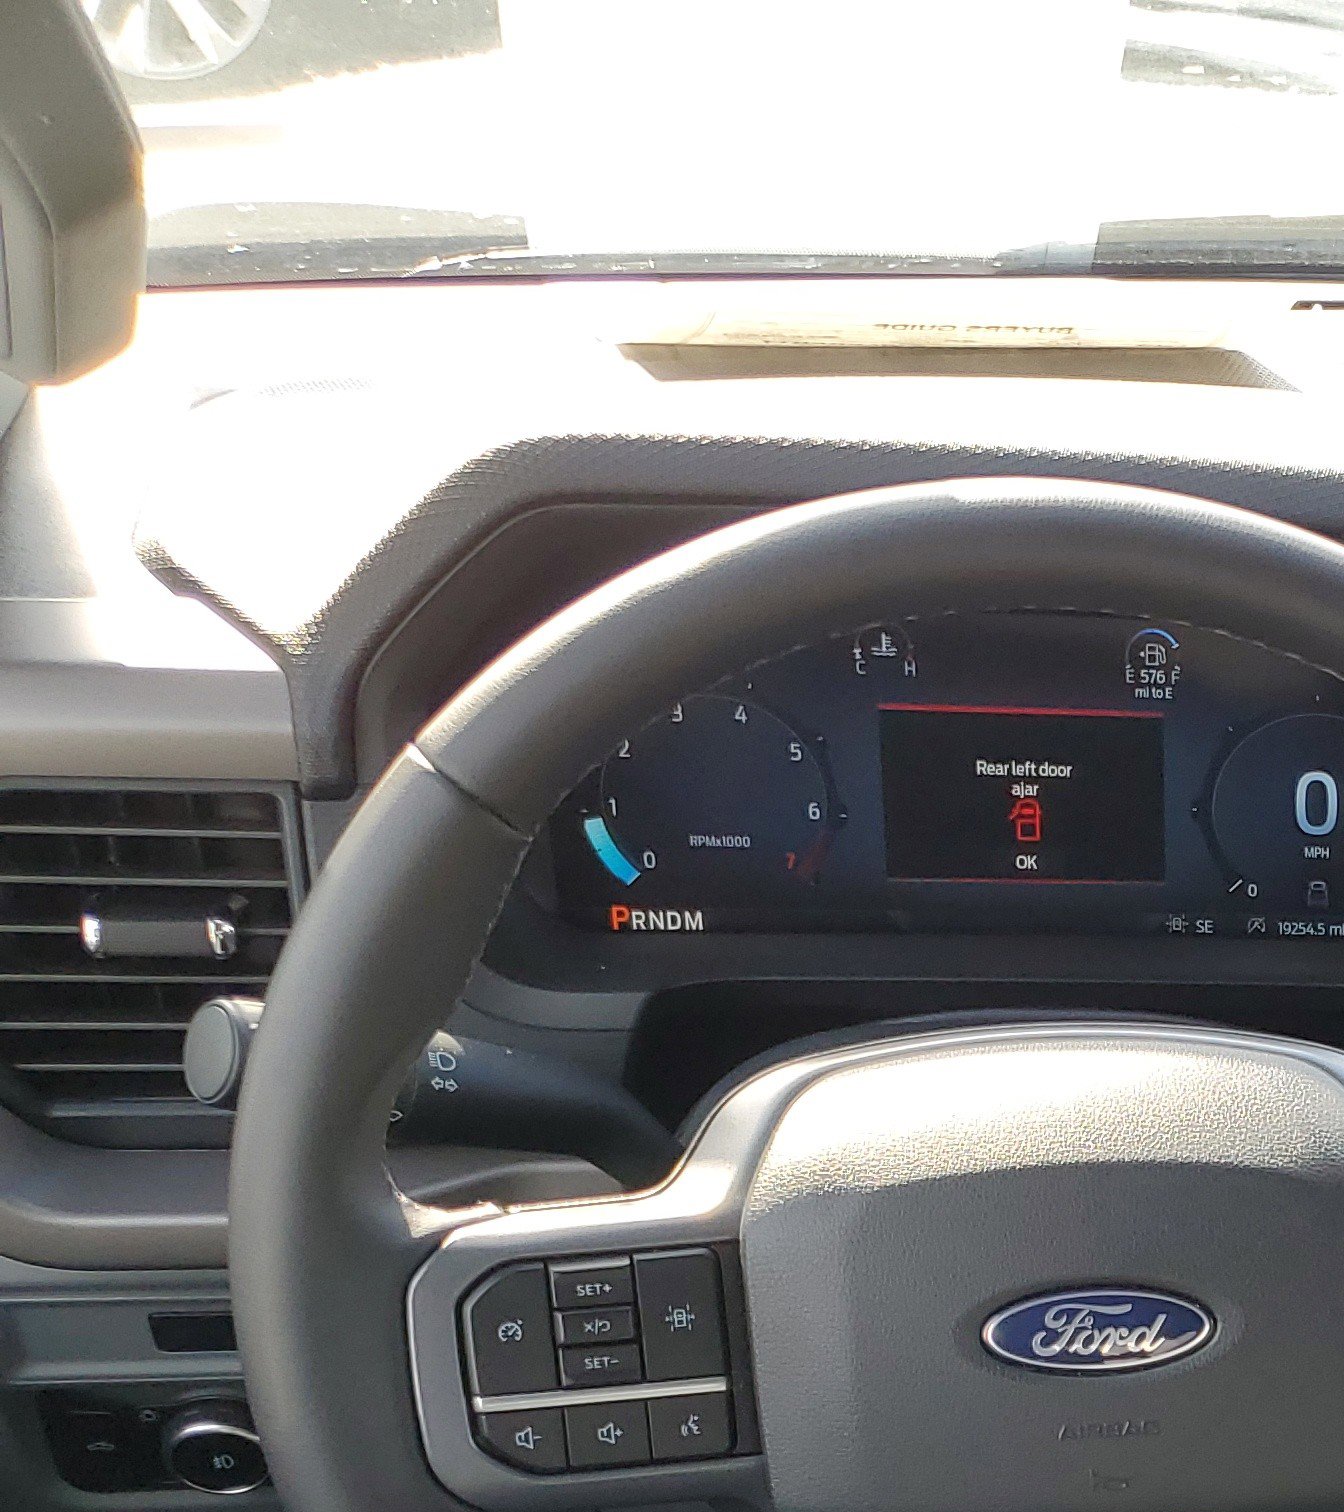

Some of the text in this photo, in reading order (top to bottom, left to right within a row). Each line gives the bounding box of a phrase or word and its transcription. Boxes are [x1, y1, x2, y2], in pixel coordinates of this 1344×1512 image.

[856, 661, 866, 675] C
[904, 661, 916, 677] H
[1125, 669, 1181, 685] E 576 F
[1151, 687, 1164, 699] to
[1165, 687, 1173, 699] E
[671, 703, 683, 722] 3
[734, 705, 747, 723] 4
[618, 740, 631, 758] 2
[789, 743, 802, 761] 5
[976, 761, 1073, 778] Rear left door
[1011, 782, 1039, 798] ajar
[608, 798, 618, 817] 1
[808, 803, 820, 820] 6
[1294, 770, 1339, 837] 0
[642, 851, 657, 869] 0
[1304, 845, 1330, 859] MPH
[1015, 855, 1038, 870] OK
[1247, 884, 1258, 898] 0
[1195, 920, 1214, 935] SE
[1277, 921, 1326, 937] 19254.5
[576, 1283, 613, 1297] SET+
[1032, 1303, 1196, 1356] Ford
